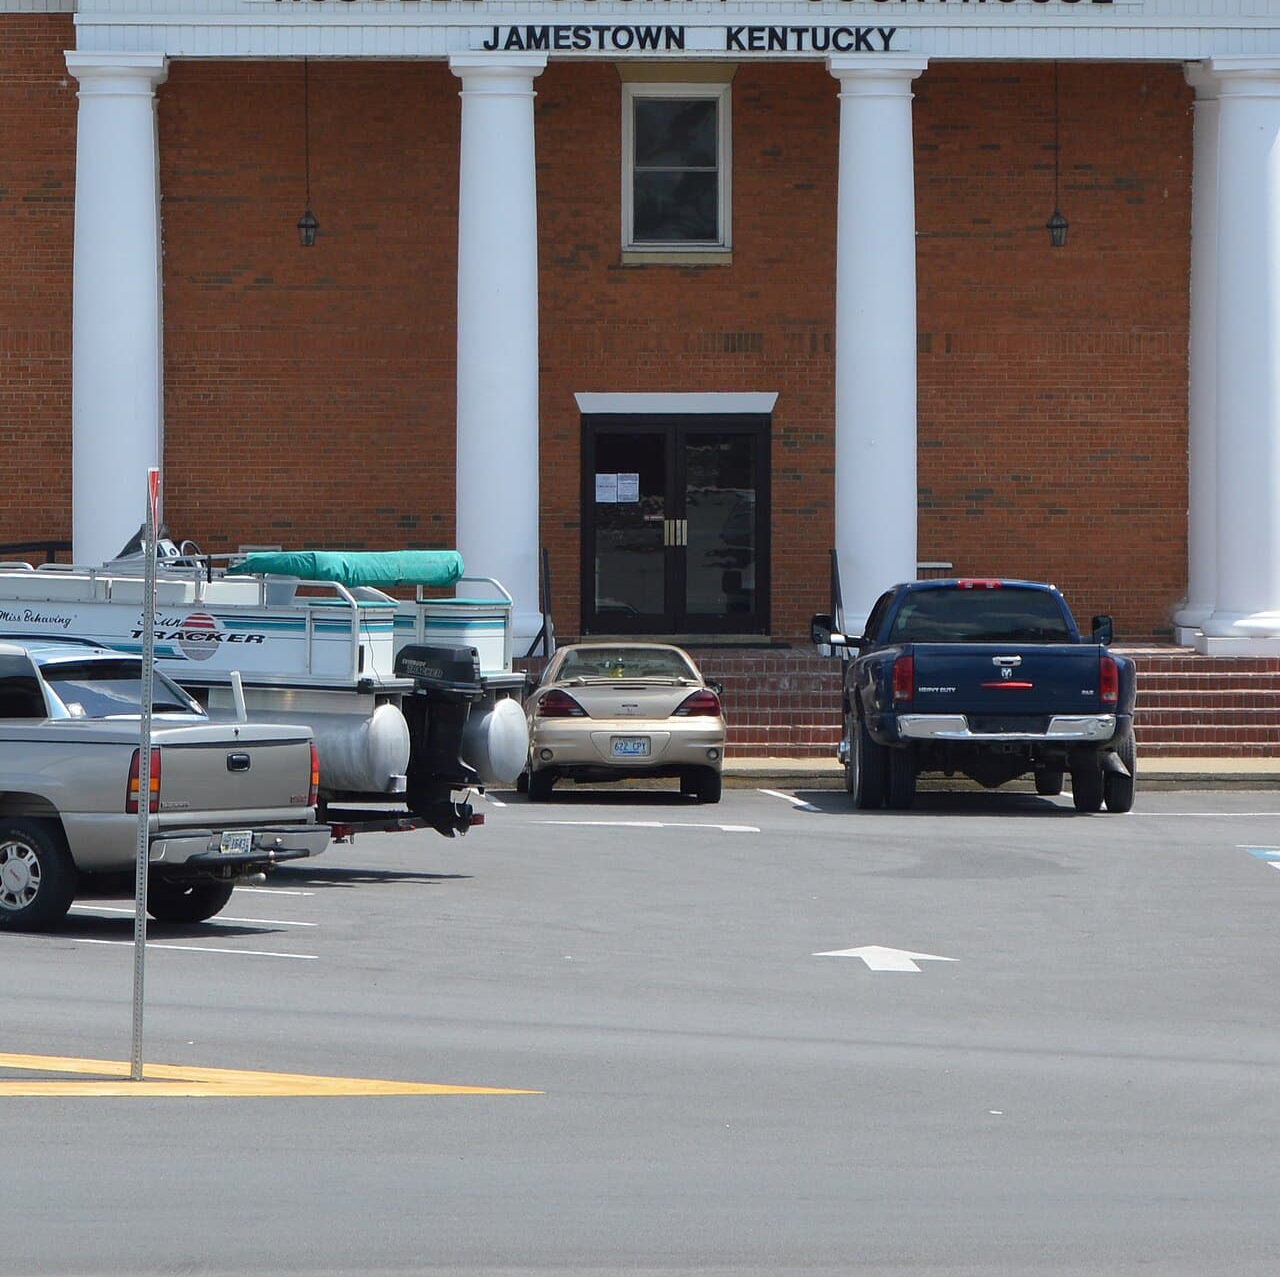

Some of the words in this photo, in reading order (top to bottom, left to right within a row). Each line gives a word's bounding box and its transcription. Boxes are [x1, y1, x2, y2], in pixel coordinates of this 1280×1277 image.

[483, 25, 685, 51] JAMESTOWN
[726, 26, 897, 52] KENTUCKY
[130, 629, 266, 645] TRACKER
[614, 742, 629, 751] 622
